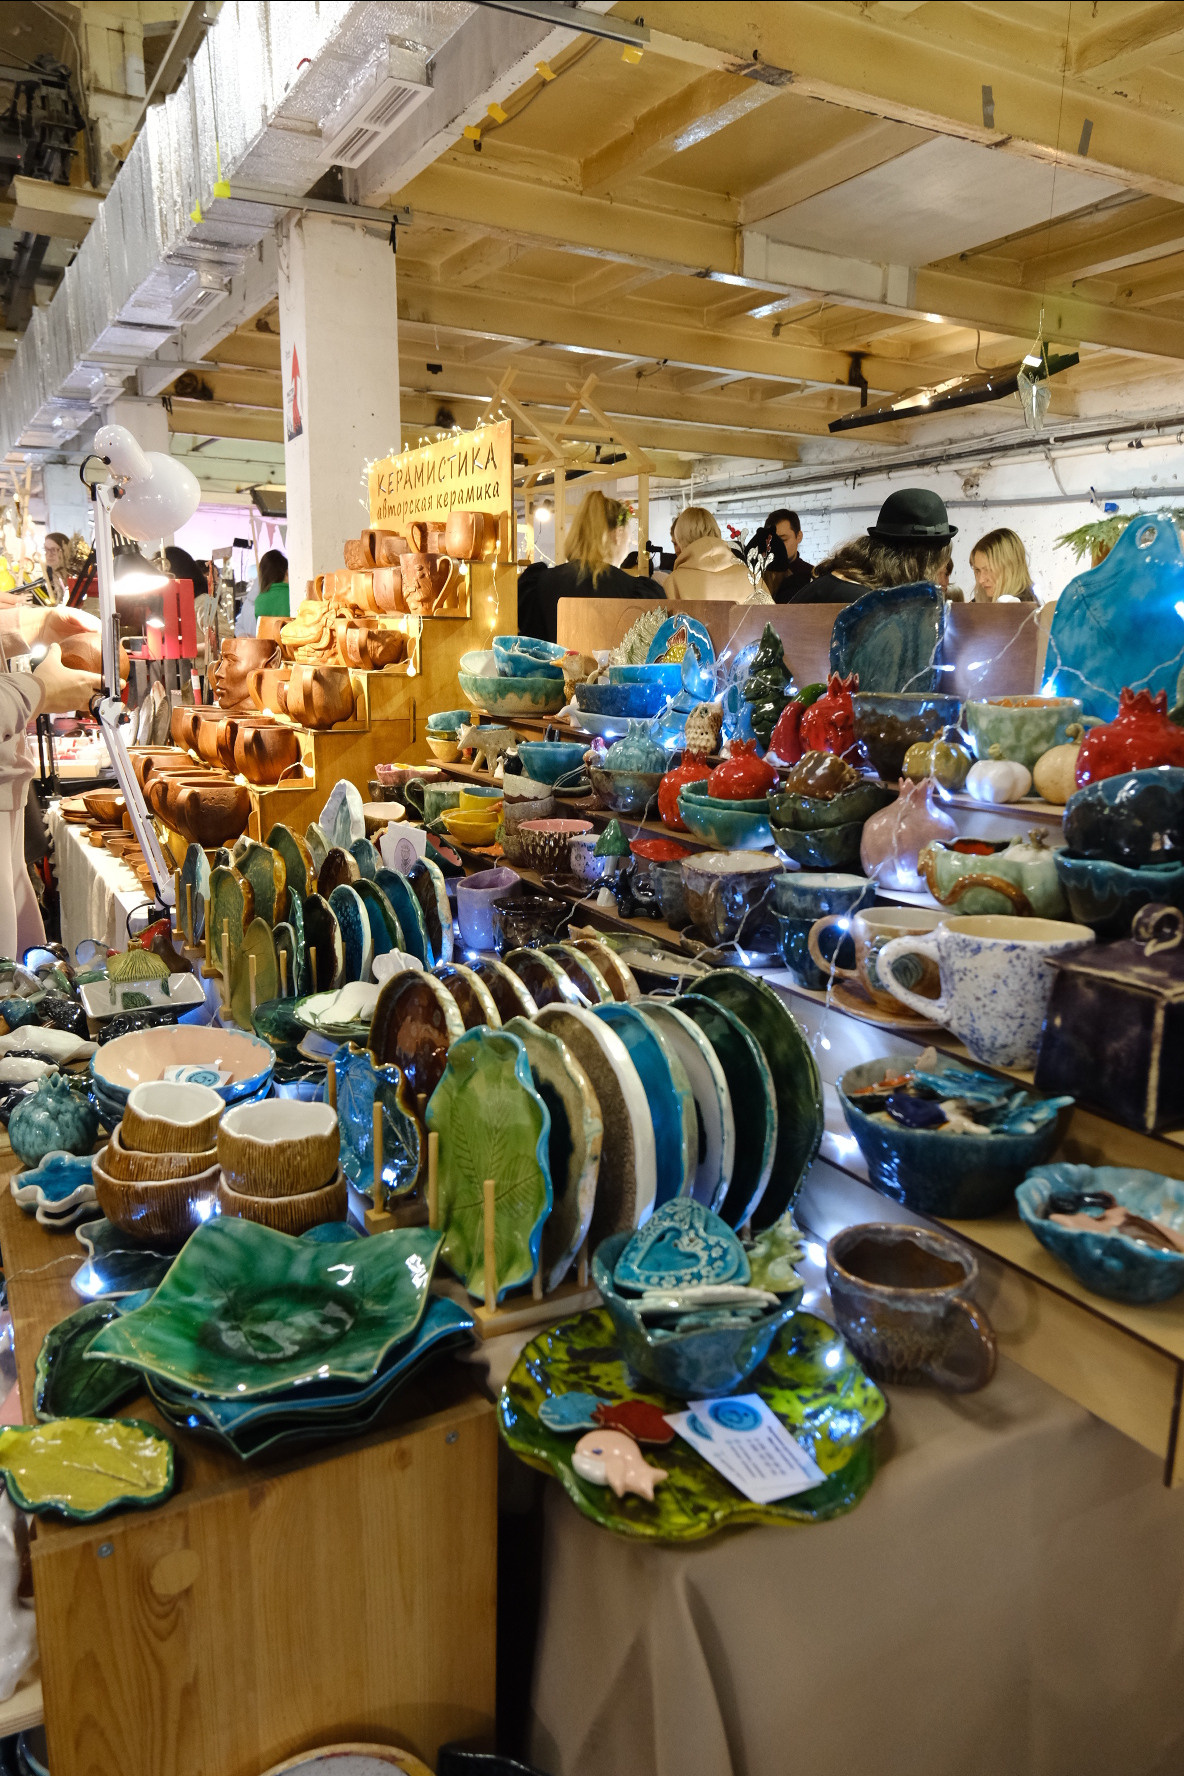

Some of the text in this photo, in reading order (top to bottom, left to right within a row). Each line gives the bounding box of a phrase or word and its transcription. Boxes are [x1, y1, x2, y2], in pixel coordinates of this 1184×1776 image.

[377, 442, 498, 497] КЕРАМИСТИКА
[376, 481, 500, 524] авторская керамика
